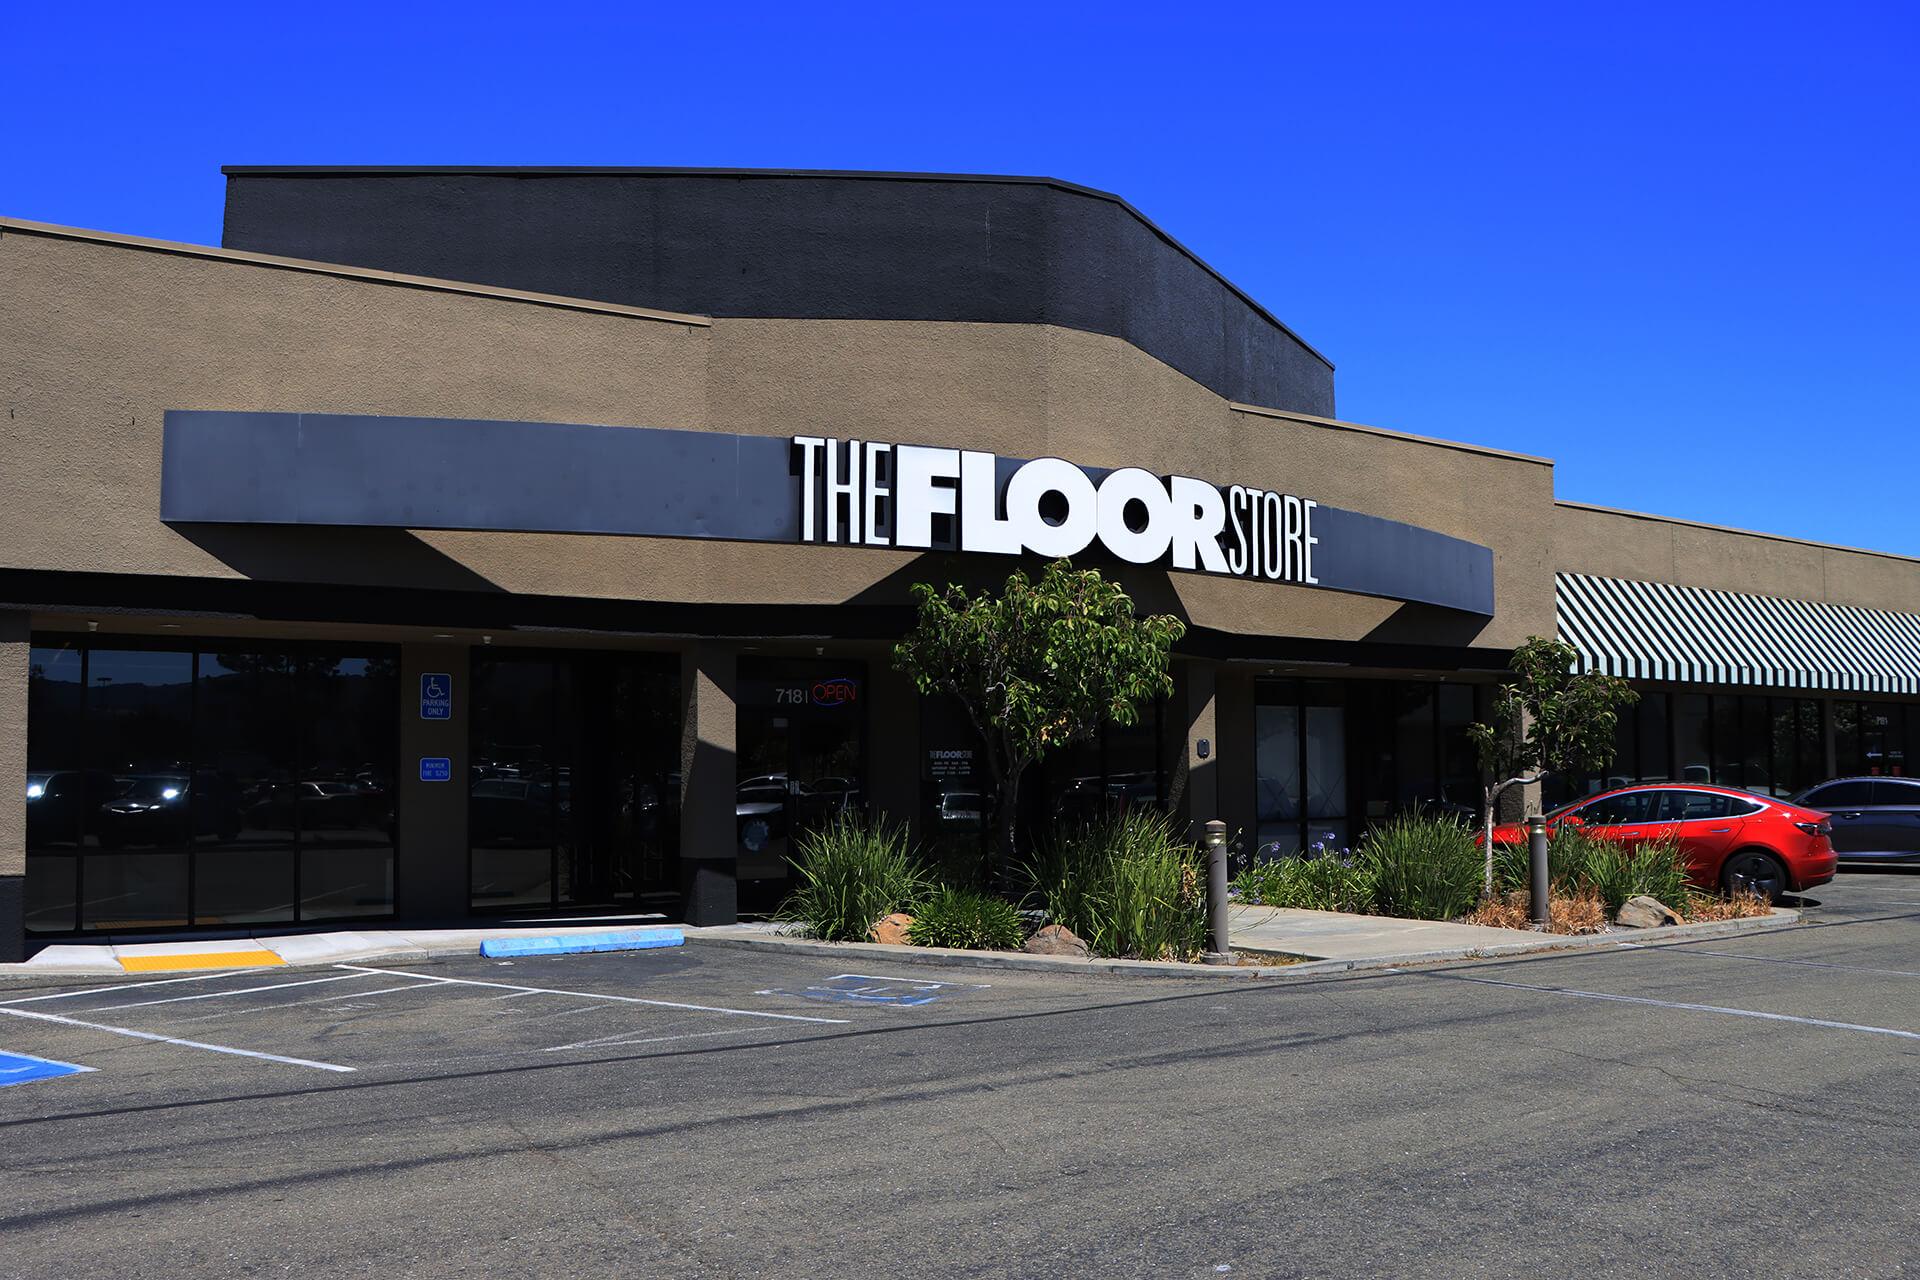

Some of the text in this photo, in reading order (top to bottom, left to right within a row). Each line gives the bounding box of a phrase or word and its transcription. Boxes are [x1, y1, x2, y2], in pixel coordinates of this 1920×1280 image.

[793, 436, 1319, 585] THE FLOOR STORE
[812, 683, 856, 701] OPEN
[422, 698, 449, 707] PARKING
[427, 707, 444, 717] ONLY
